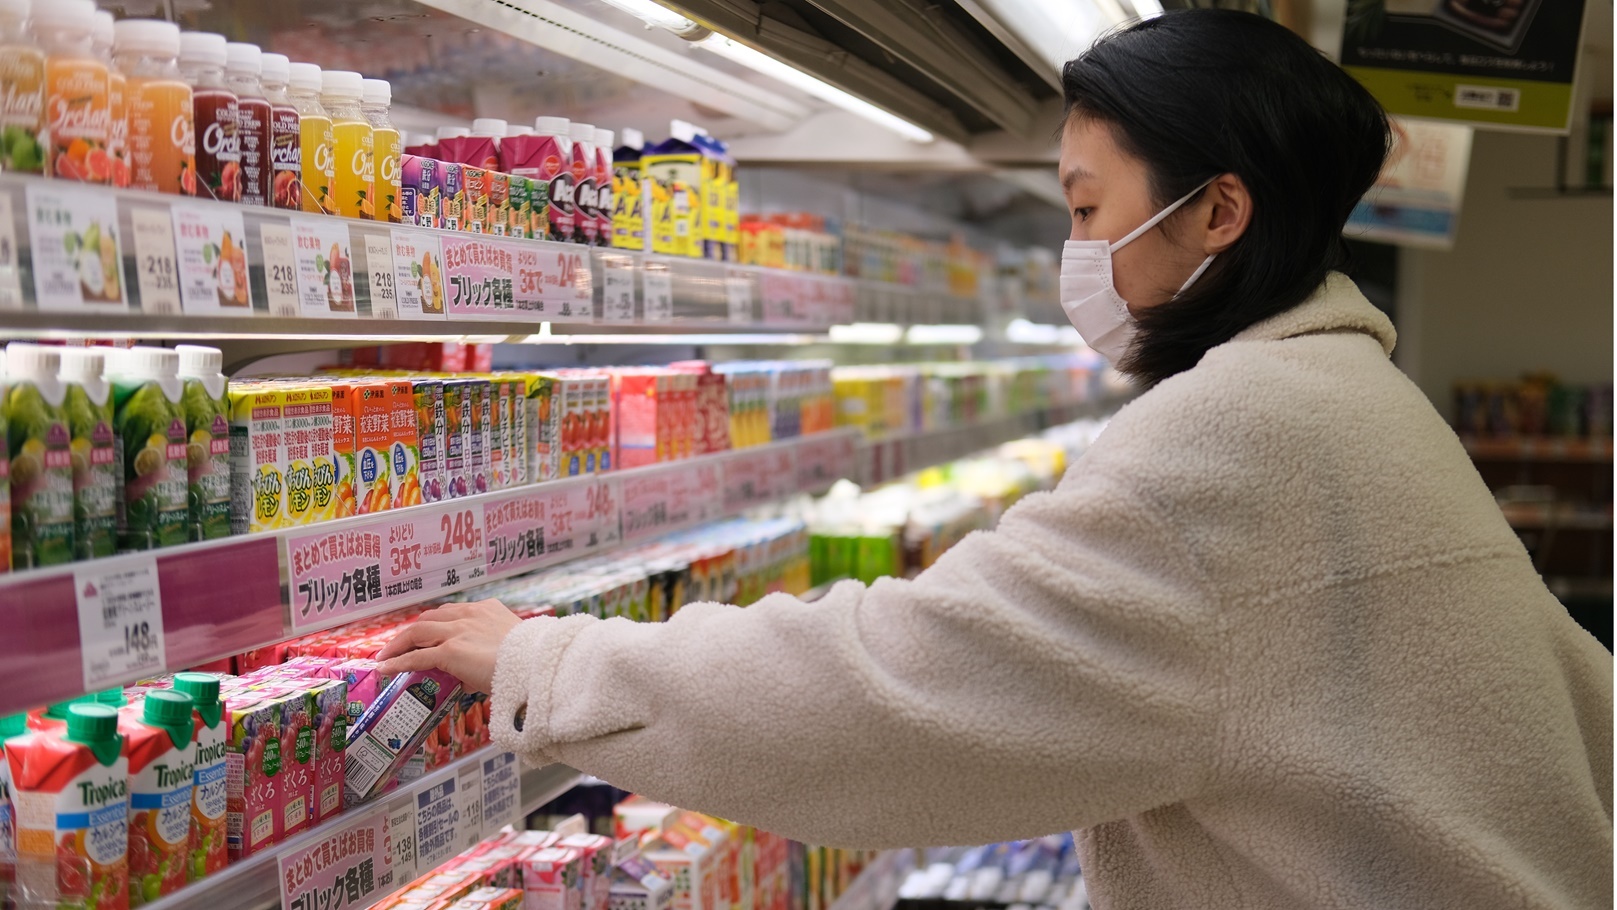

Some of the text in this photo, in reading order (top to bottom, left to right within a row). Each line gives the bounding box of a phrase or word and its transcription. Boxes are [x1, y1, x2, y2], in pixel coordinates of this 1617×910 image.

[273, 265, 293, 281] 218
[375, 272, 391, 287] 218
[450, 275, 514, 308] ブリック各種
[435, 403, 443, 435] 鉄分
[462, 402, 470, 434] 鉄分
[500, 399, 511, 485] マルチビタミン
[389, 523, 414, 544] よりどり
[489, 527, 545, 566] ブリック各種
[293, 533, 380, 575] まとめて買えばお買得
[390, 543, 421, 576] 3本で
[299, 563, 382, 617] ブリック各種
[283, 768, 307, 792] ざくろ
[319, 756, 342, 779] ざくろ
[250, 781, 275, 806] ざくろ
[285, 827, 375, 894] まとめて買えばお買得
[396, 836, 411, 856] 138
[401, 851, 412, 865] 149
